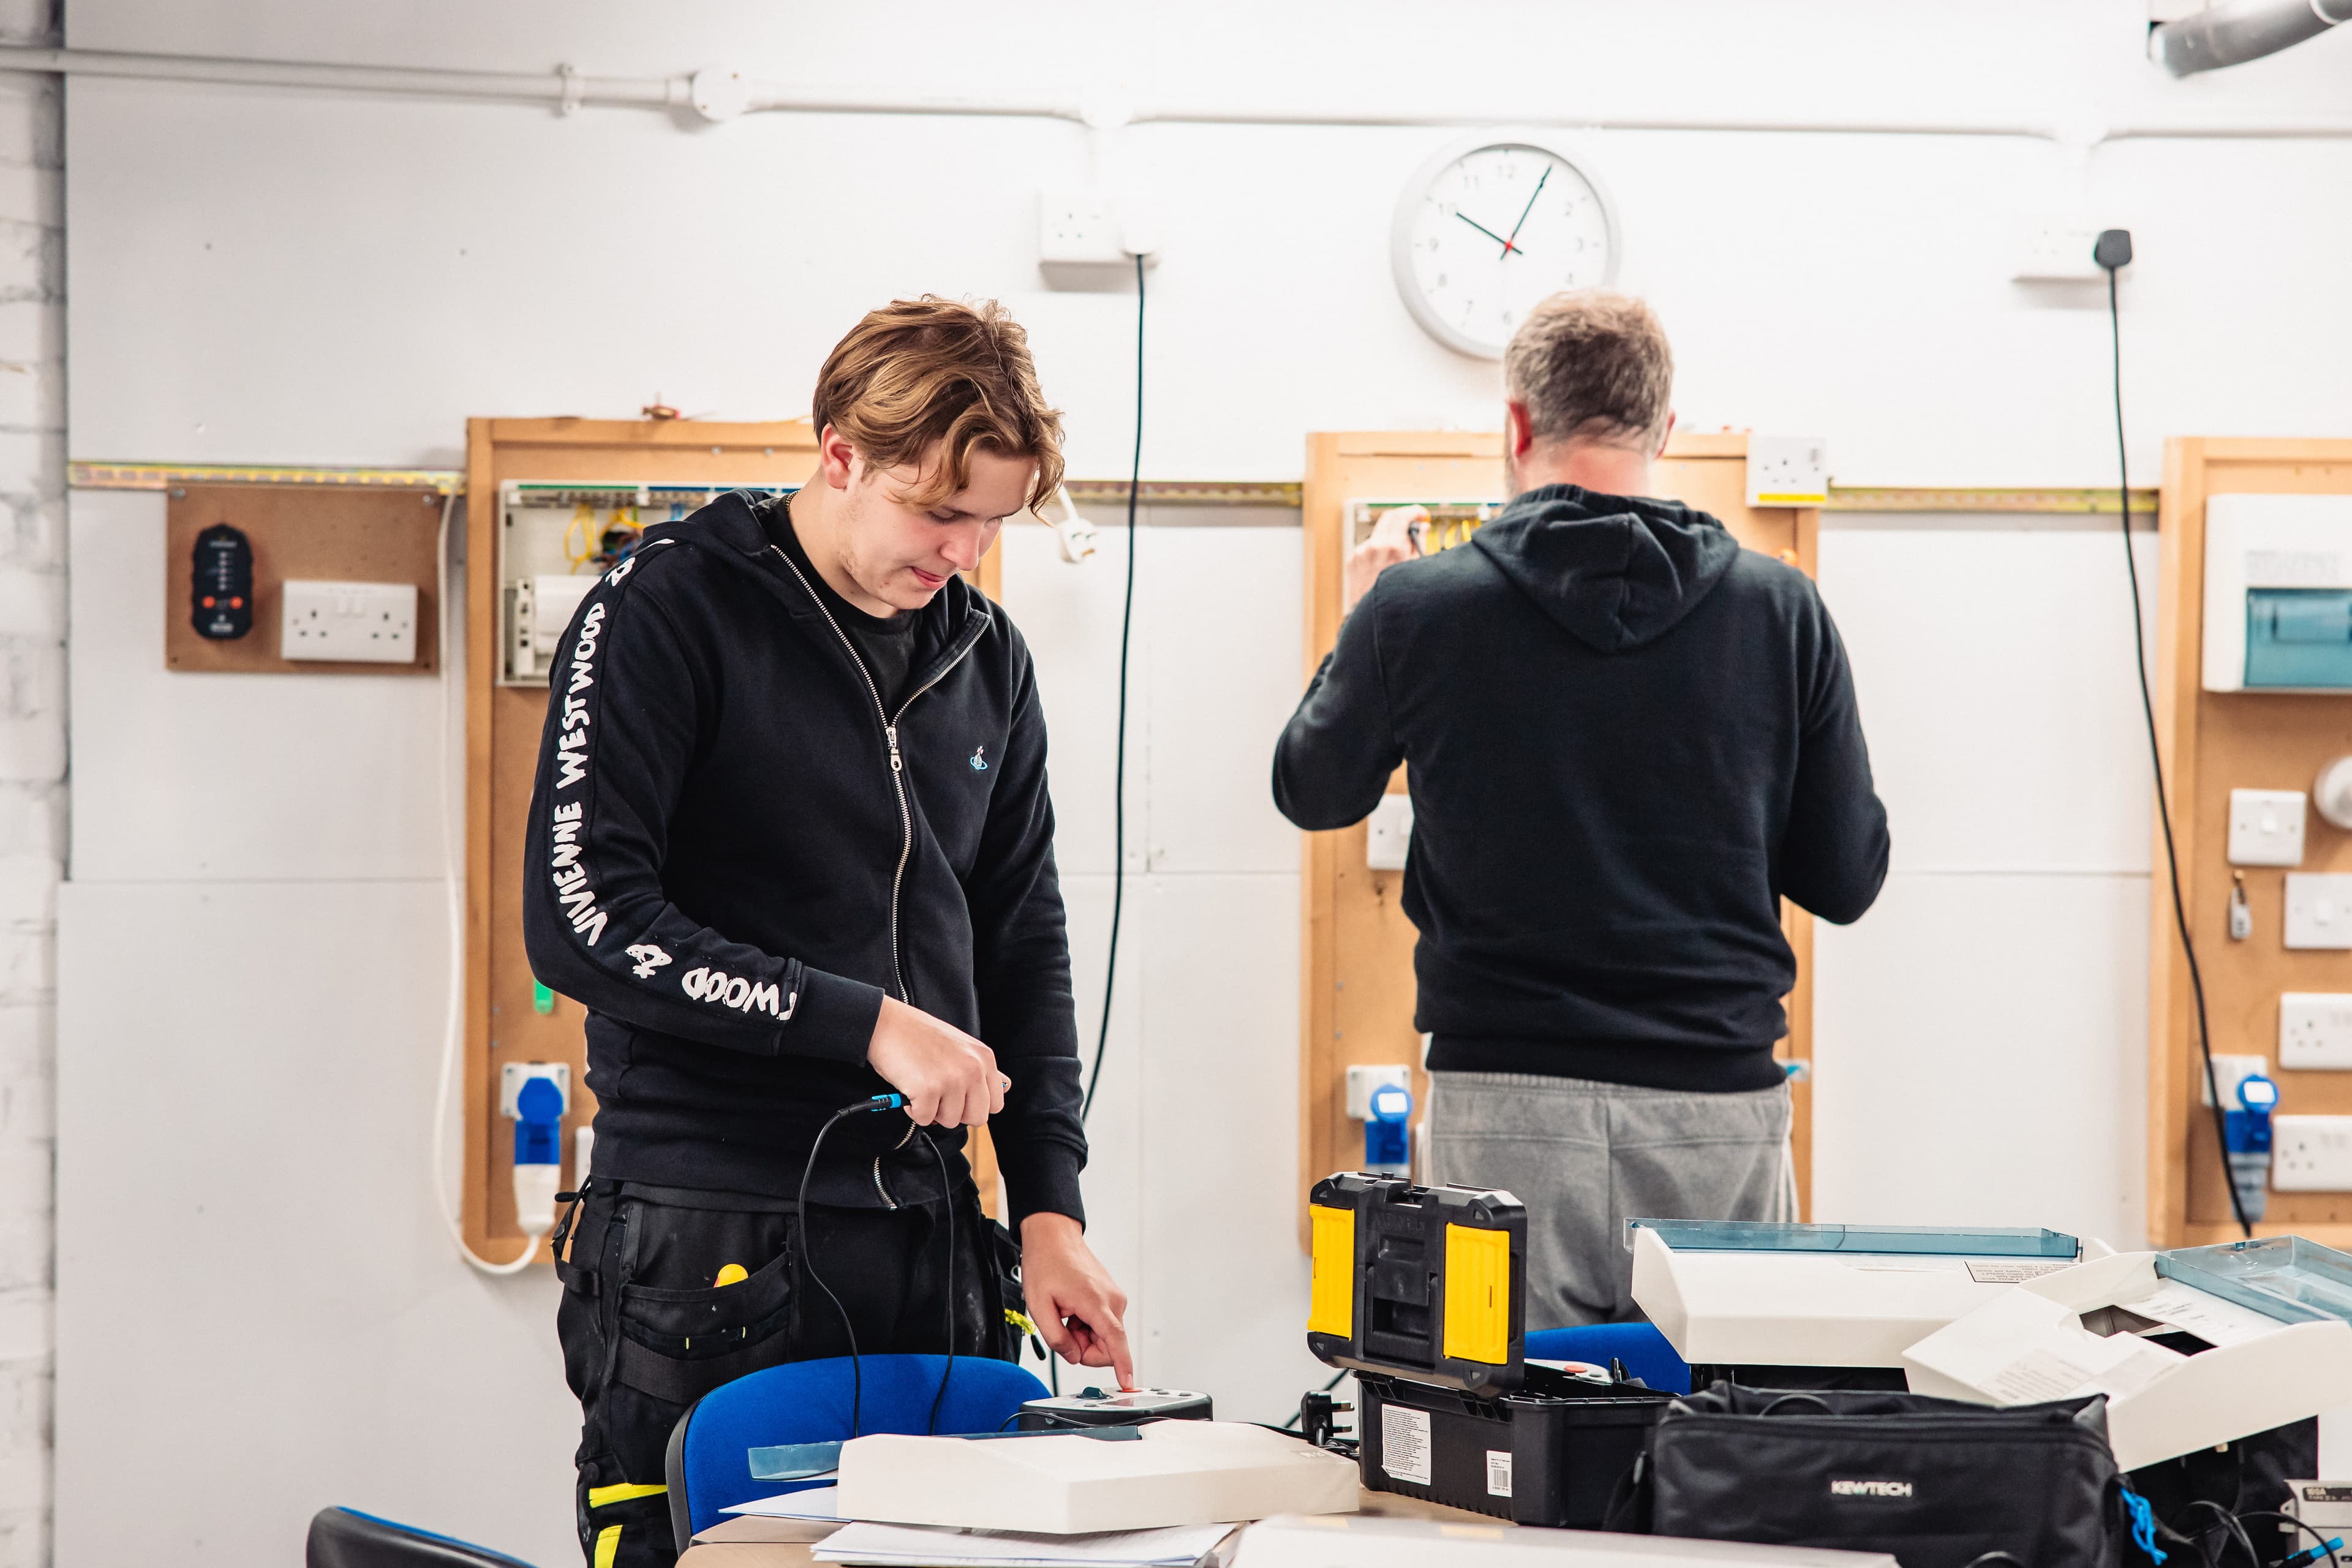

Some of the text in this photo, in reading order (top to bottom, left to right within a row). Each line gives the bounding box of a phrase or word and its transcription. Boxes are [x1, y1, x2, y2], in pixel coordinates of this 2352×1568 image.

[552, 602, 608, 946] VIVIENNE WESTWOOD
[1831, 1480, 1913, 1498] KEWTECH
